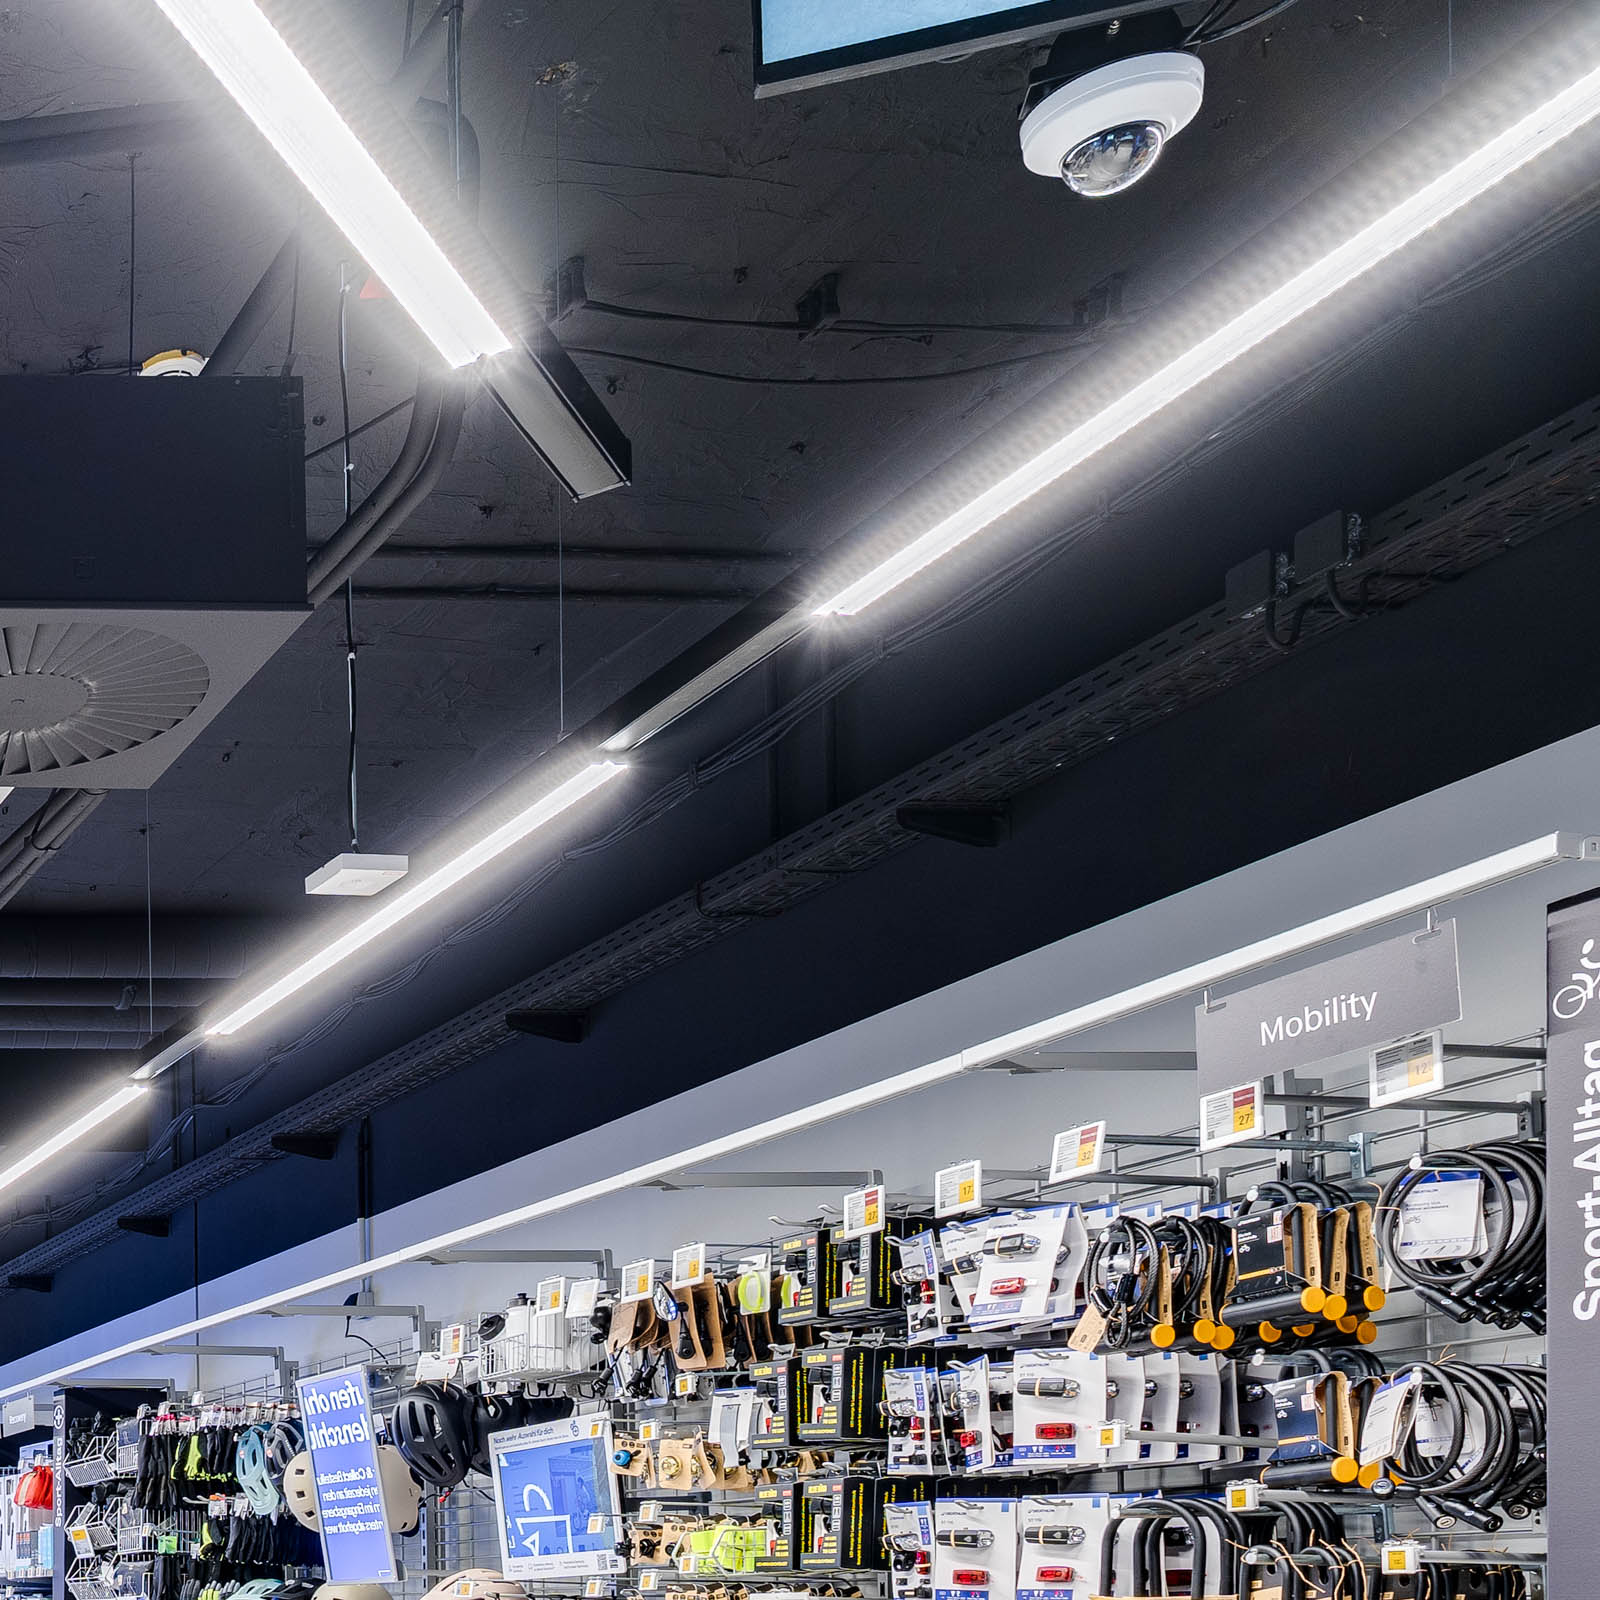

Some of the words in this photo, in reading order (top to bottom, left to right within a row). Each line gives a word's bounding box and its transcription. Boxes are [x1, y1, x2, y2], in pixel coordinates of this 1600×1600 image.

[1260, 991, 1378, 1046] Mobility
[1414, 1063, 1428, 1076] 12
[1238, 1113, 1250, 1126] 27
[1081, 1150, 1092, 1162] 32
[962, 1185, 972, 1195] 17
